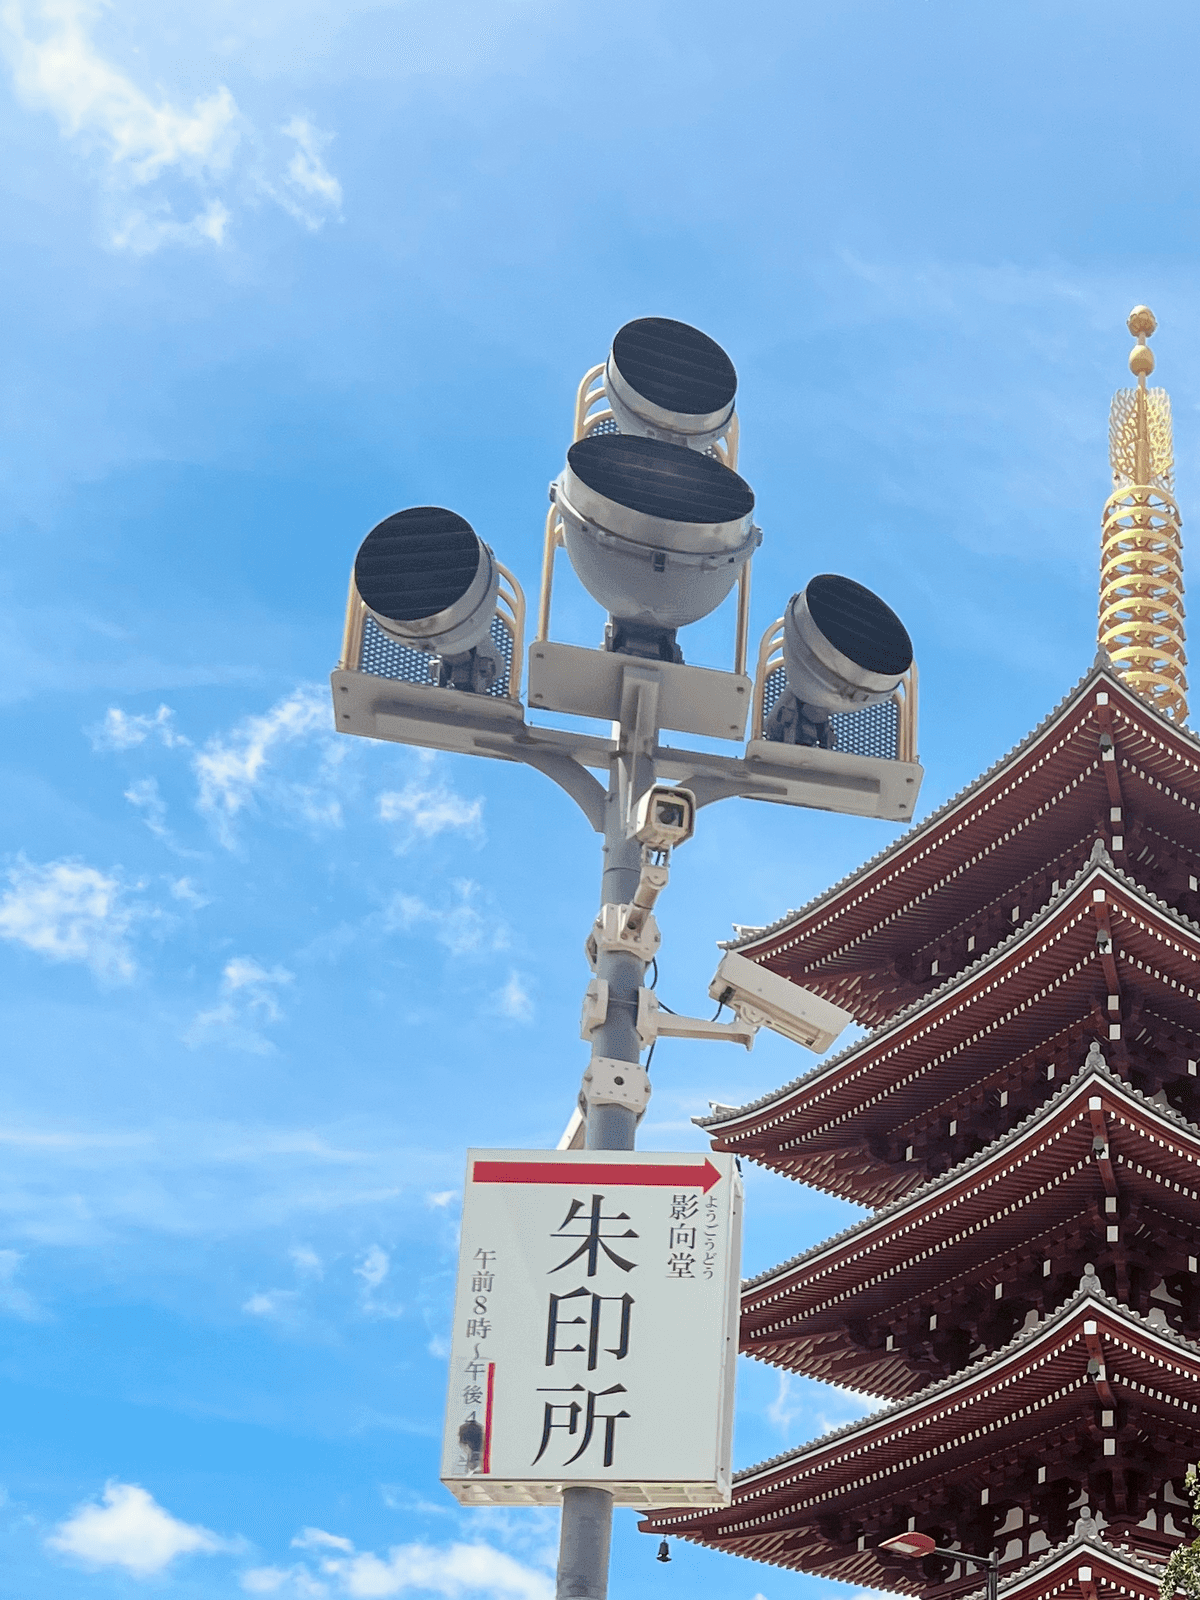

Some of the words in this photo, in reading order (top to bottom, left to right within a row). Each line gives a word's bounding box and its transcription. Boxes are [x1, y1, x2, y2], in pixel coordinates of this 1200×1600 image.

[665, 1194, 699, 1279] 影向堂
[702, 1195, 719, 1280] ようこうどう
[531, 1194, 640, 1468] 朱印所
